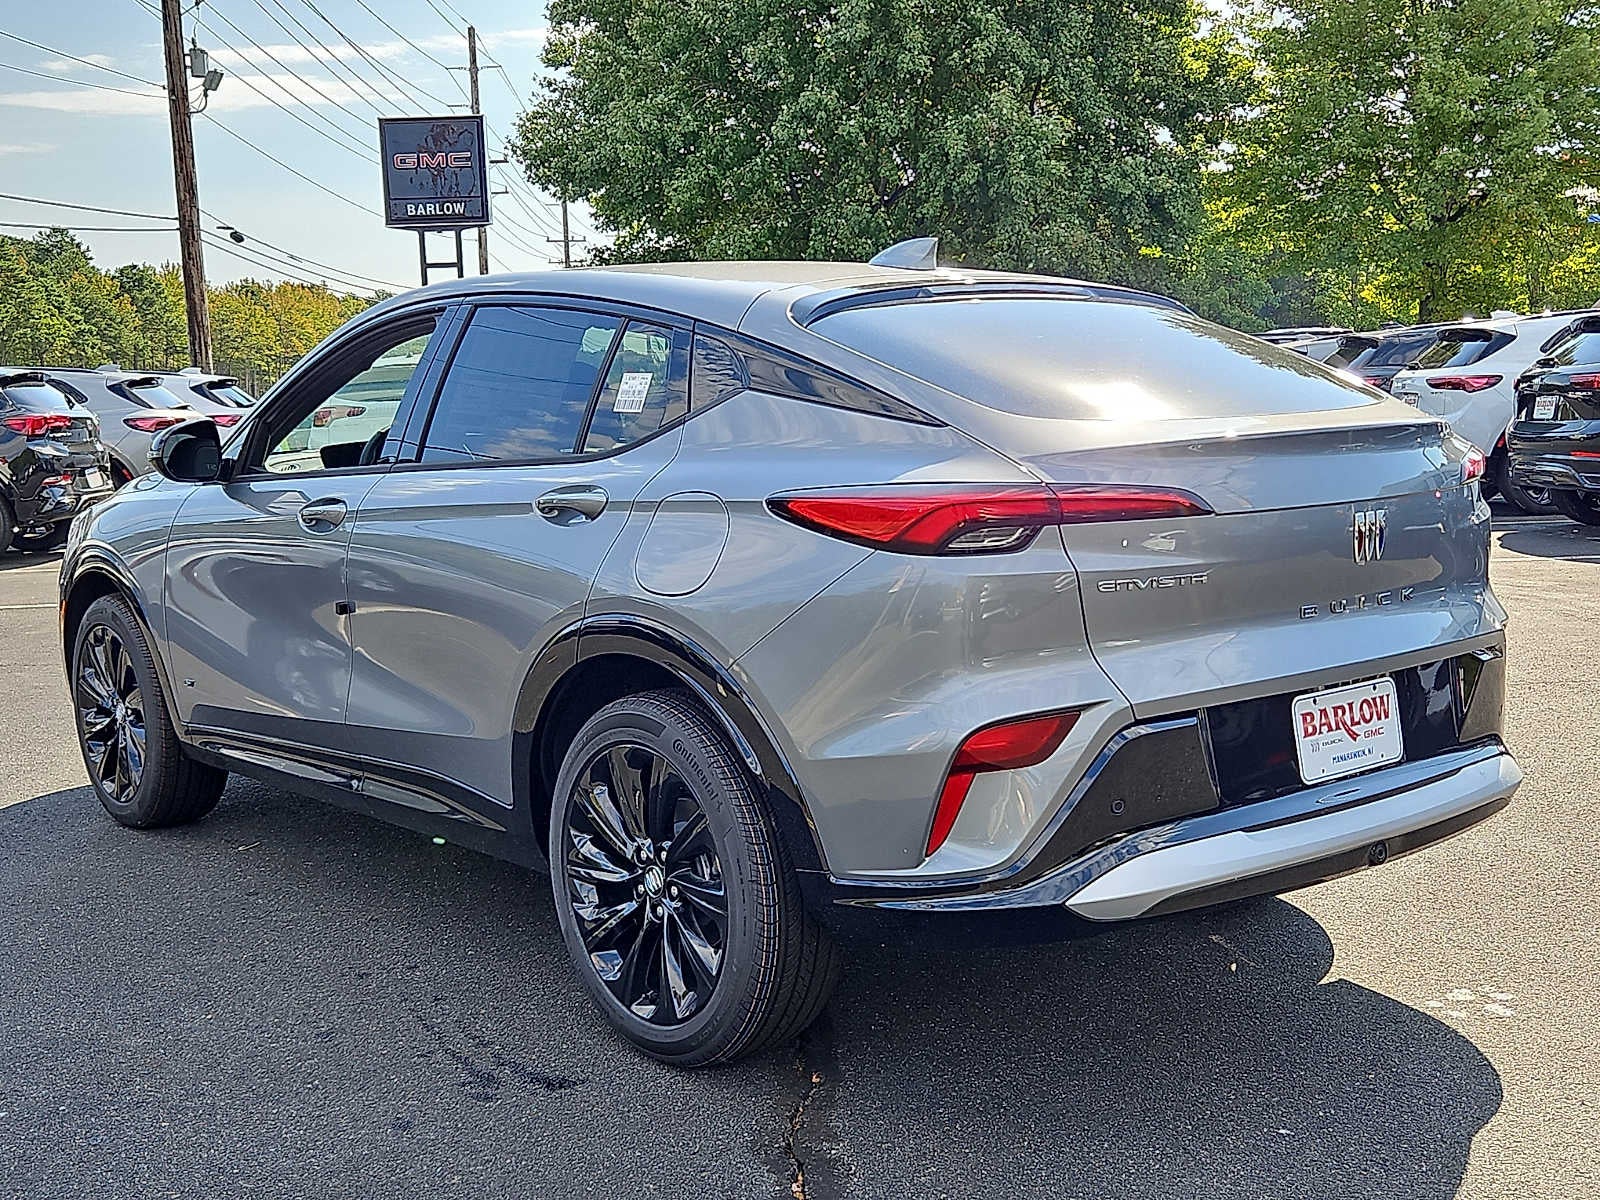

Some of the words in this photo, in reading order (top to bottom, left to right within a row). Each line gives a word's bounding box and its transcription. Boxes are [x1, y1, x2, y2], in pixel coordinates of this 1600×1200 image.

[393, 152, 472, 169] GMC
[406, 202, 465, 216] BARLOW
[1097, 572, 1209, 593] ENVISTA
[1299, 586, 1416, 619] BUICK
[1300, 693, 1391, 742] BARLOW
[1363, 726, 1385, 739] GMC
[672, 738, 719, 801] Continental
